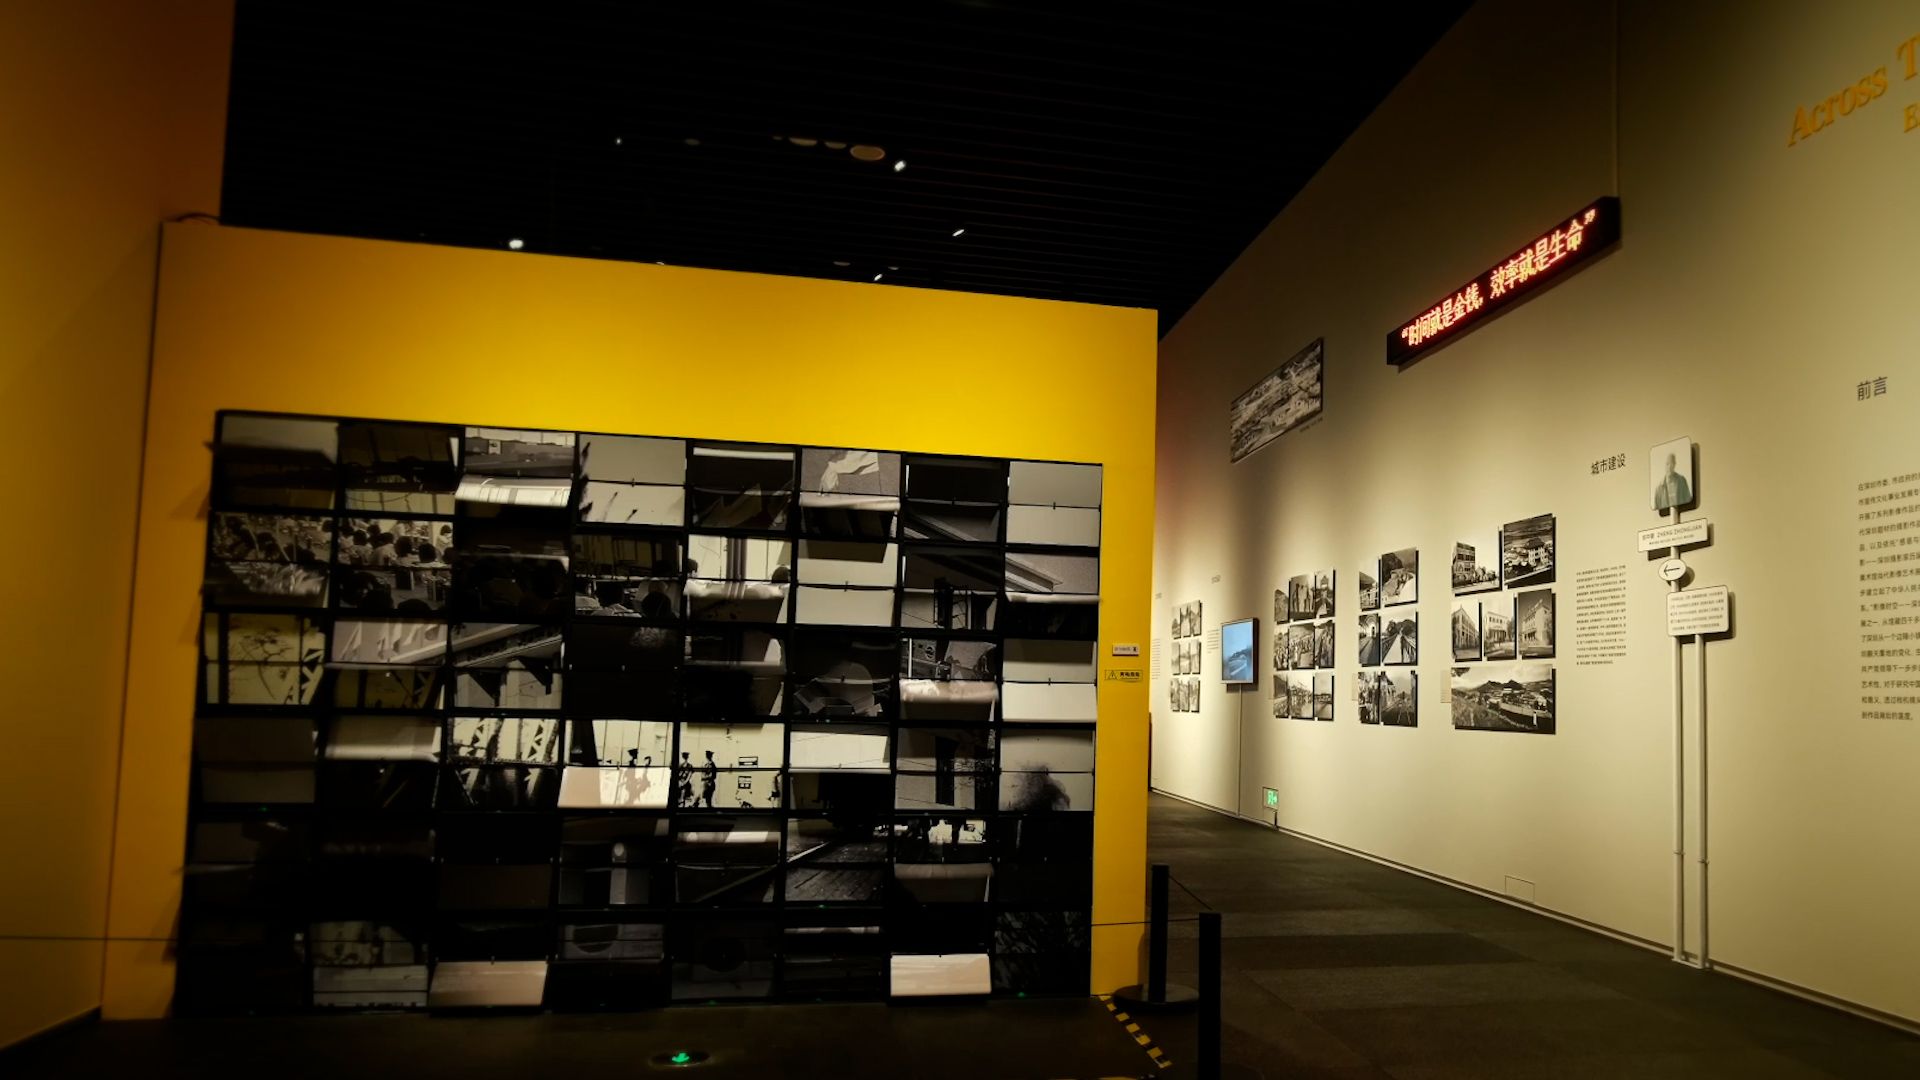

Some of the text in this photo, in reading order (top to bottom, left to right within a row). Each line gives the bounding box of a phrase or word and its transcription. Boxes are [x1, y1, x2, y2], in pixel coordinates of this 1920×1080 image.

[1787, 65, 1888, 148] Across
[1856, 376, 1888, 401] 前言
[1591, 453, 1626, 475] 城市建设
